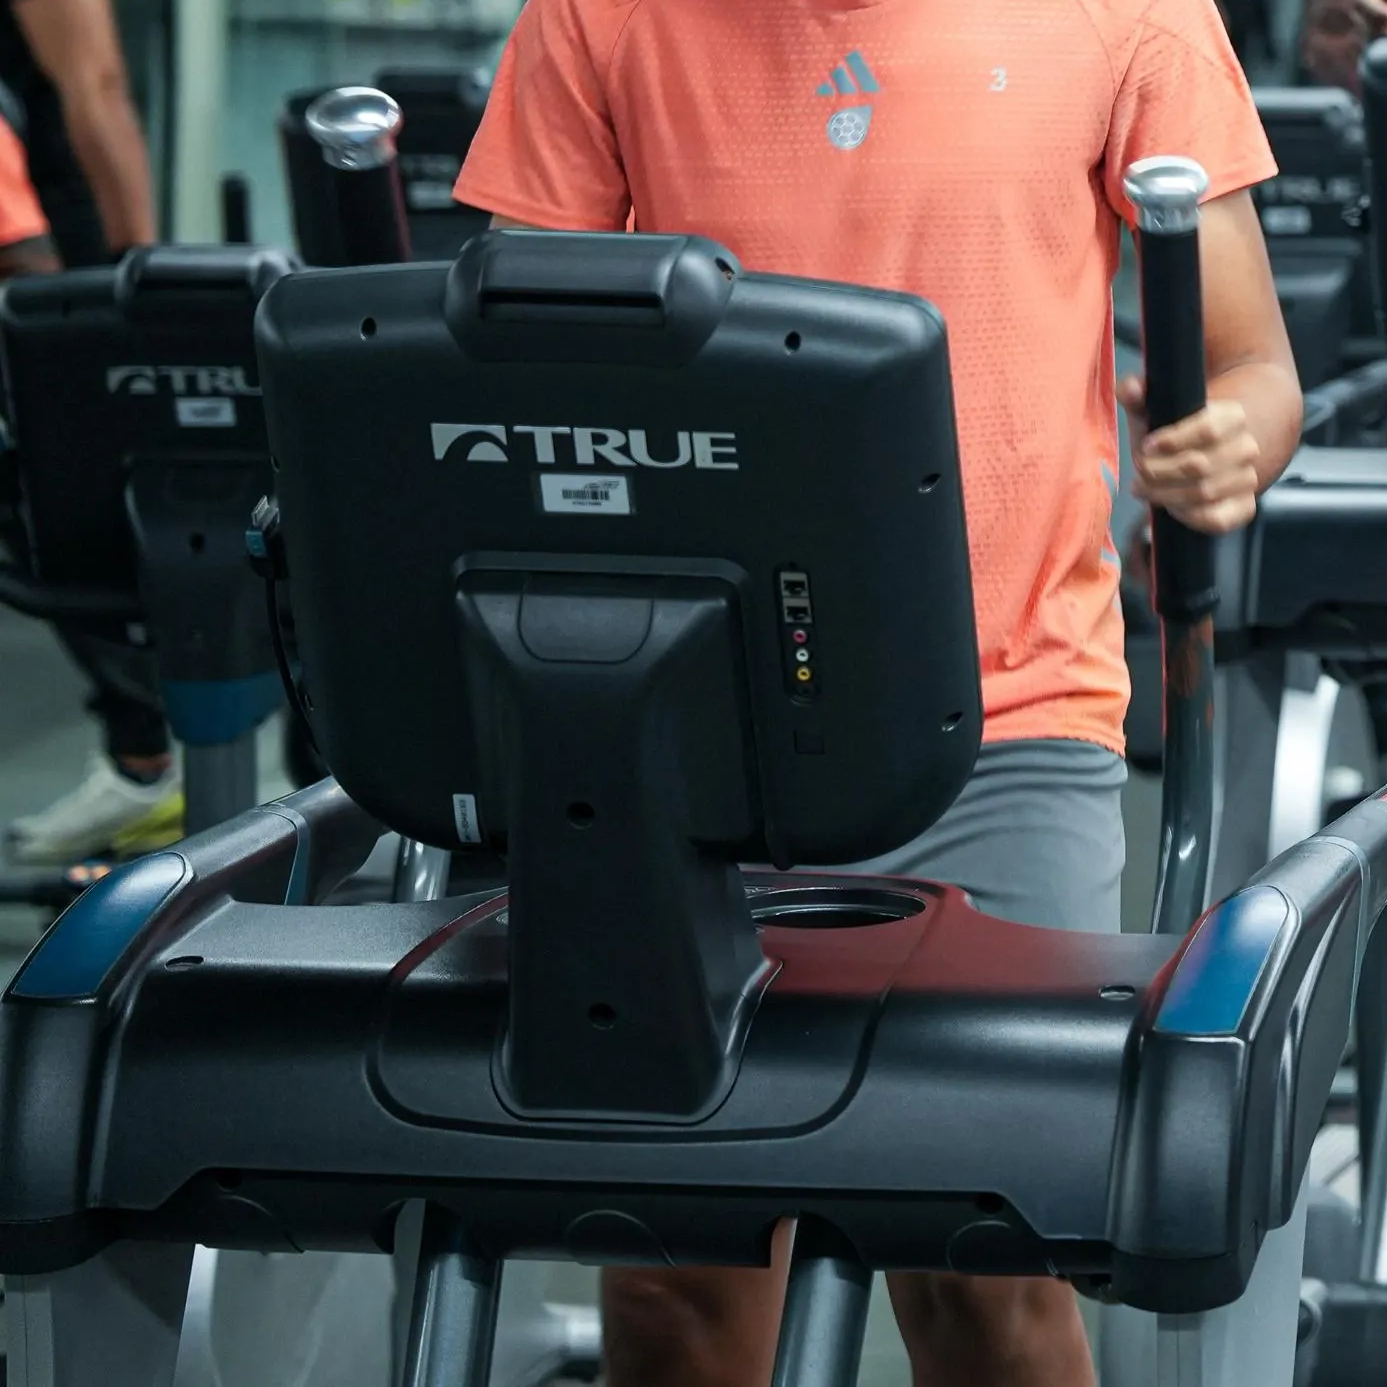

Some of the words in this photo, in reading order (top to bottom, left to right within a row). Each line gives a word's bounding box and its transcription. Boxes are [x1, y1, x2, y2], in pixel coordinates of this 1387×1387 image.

[989, 66, 1007, 91] 3
[156, 366, 263, 396] TRU
[512, 424, 739, 470] TRUE
